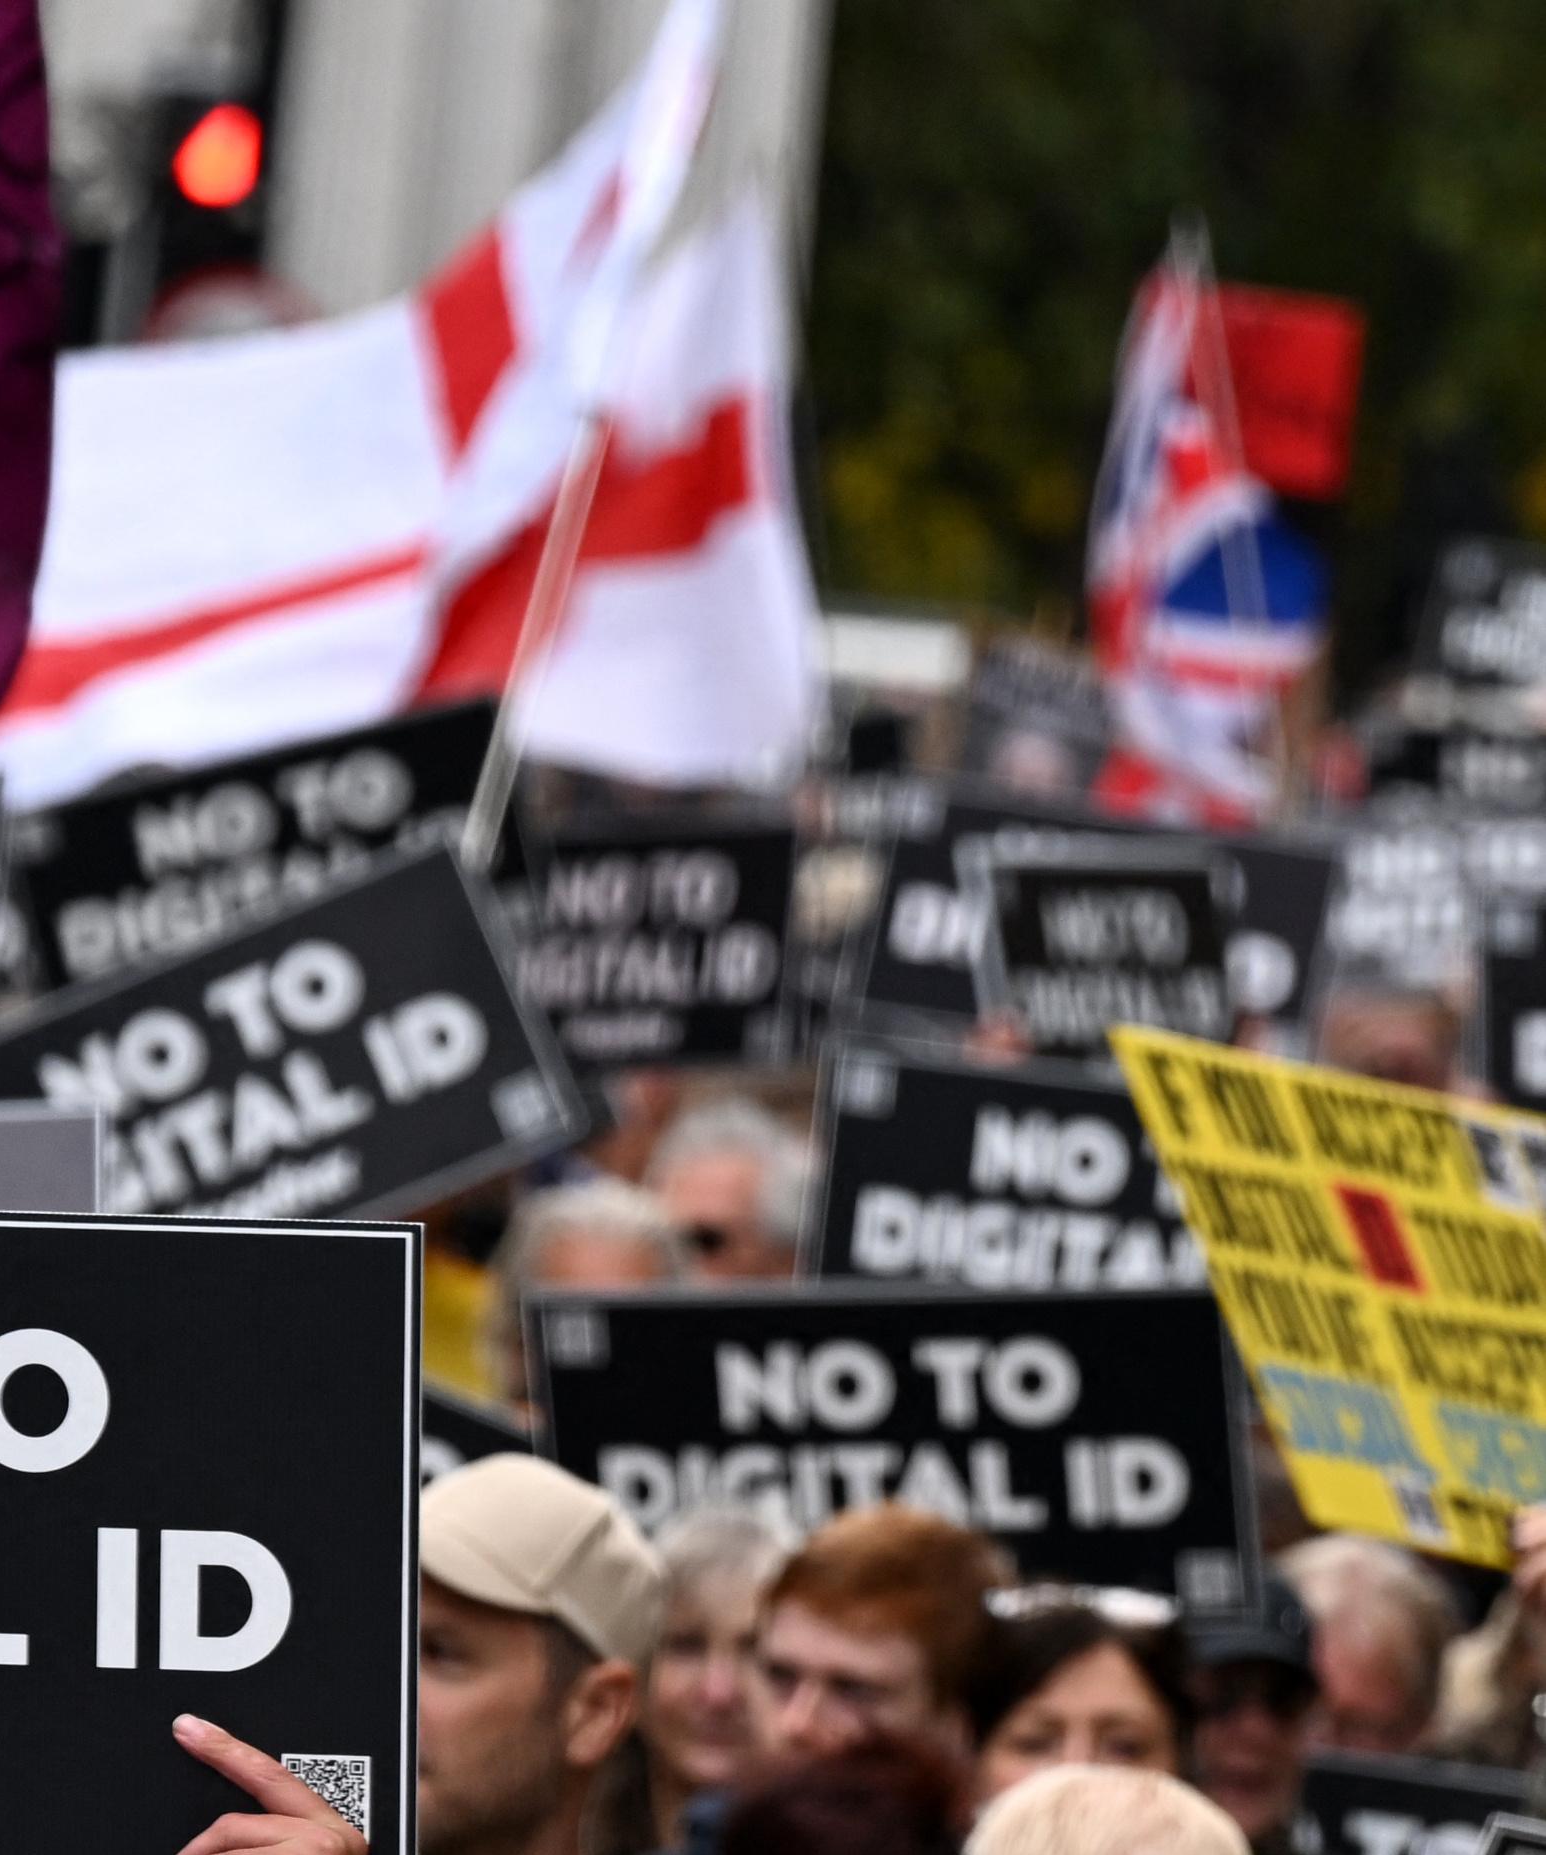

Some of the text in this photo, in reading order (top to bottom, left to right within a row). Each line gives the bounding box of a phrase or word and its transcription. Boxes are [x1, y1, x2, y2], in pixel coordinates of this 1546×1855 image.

[133, 783, 278, 876] NO
[278, 747, 414, 838] TO
[37, 940, 365, 1118] NO TO
[363, 991, 489, 1101] ID
[970, 1106, 1132, 1204] NO
[714, 1335, 1081, 1433] NO TO
[1064, 1436, 1191, 1530] ID
[96, 1527, 293, 1673] ID
